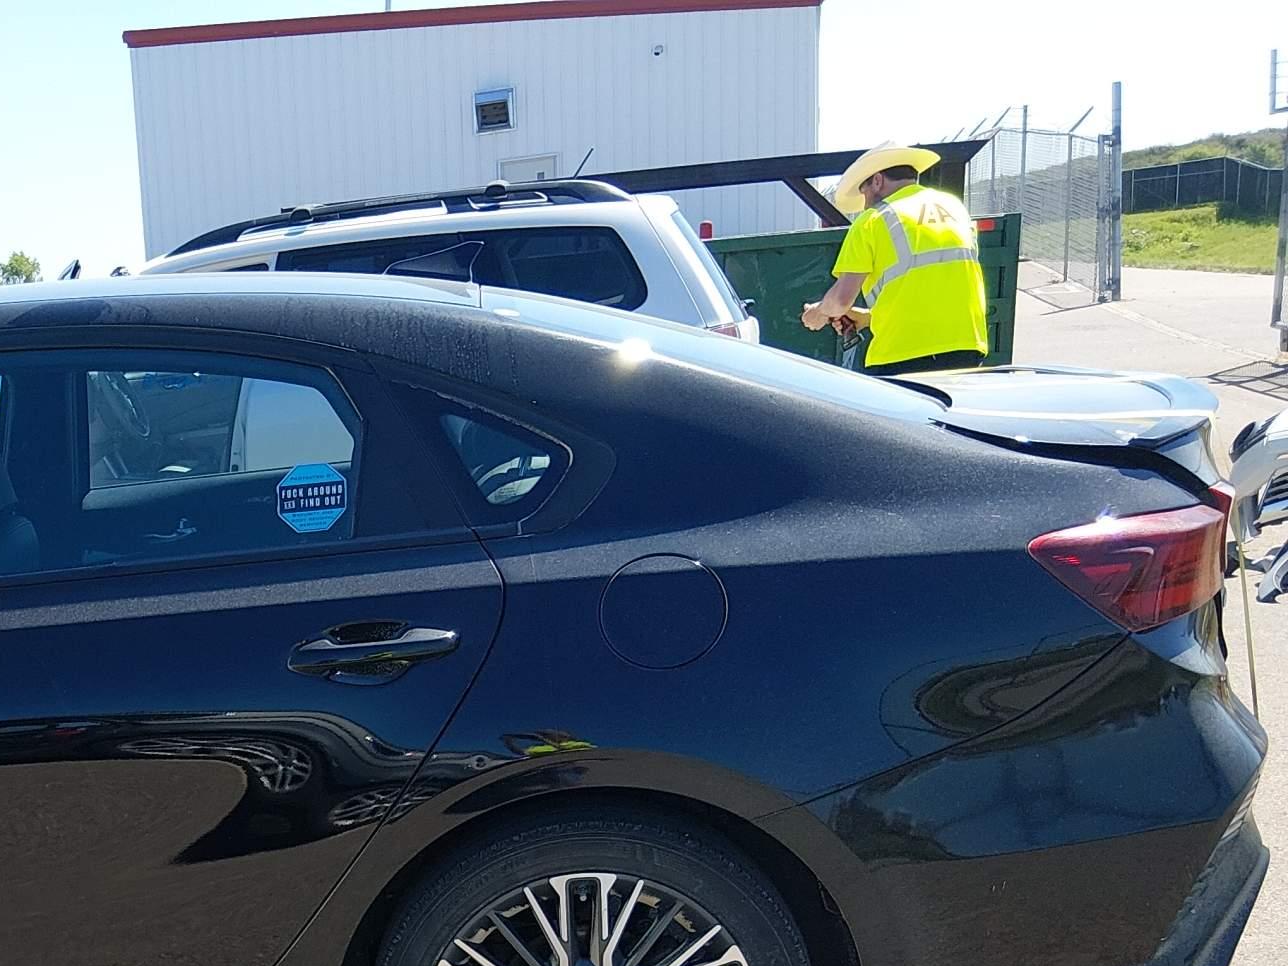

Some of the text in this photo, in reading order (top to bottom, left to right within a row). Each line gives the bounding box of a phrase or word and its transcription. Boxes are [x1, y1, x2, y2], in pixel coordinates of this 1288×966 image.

[282, 485, 342, 499] FUCK AROUND
[300, 498, 320, 508] FIND
[324, 495, 341, 505] OUT
